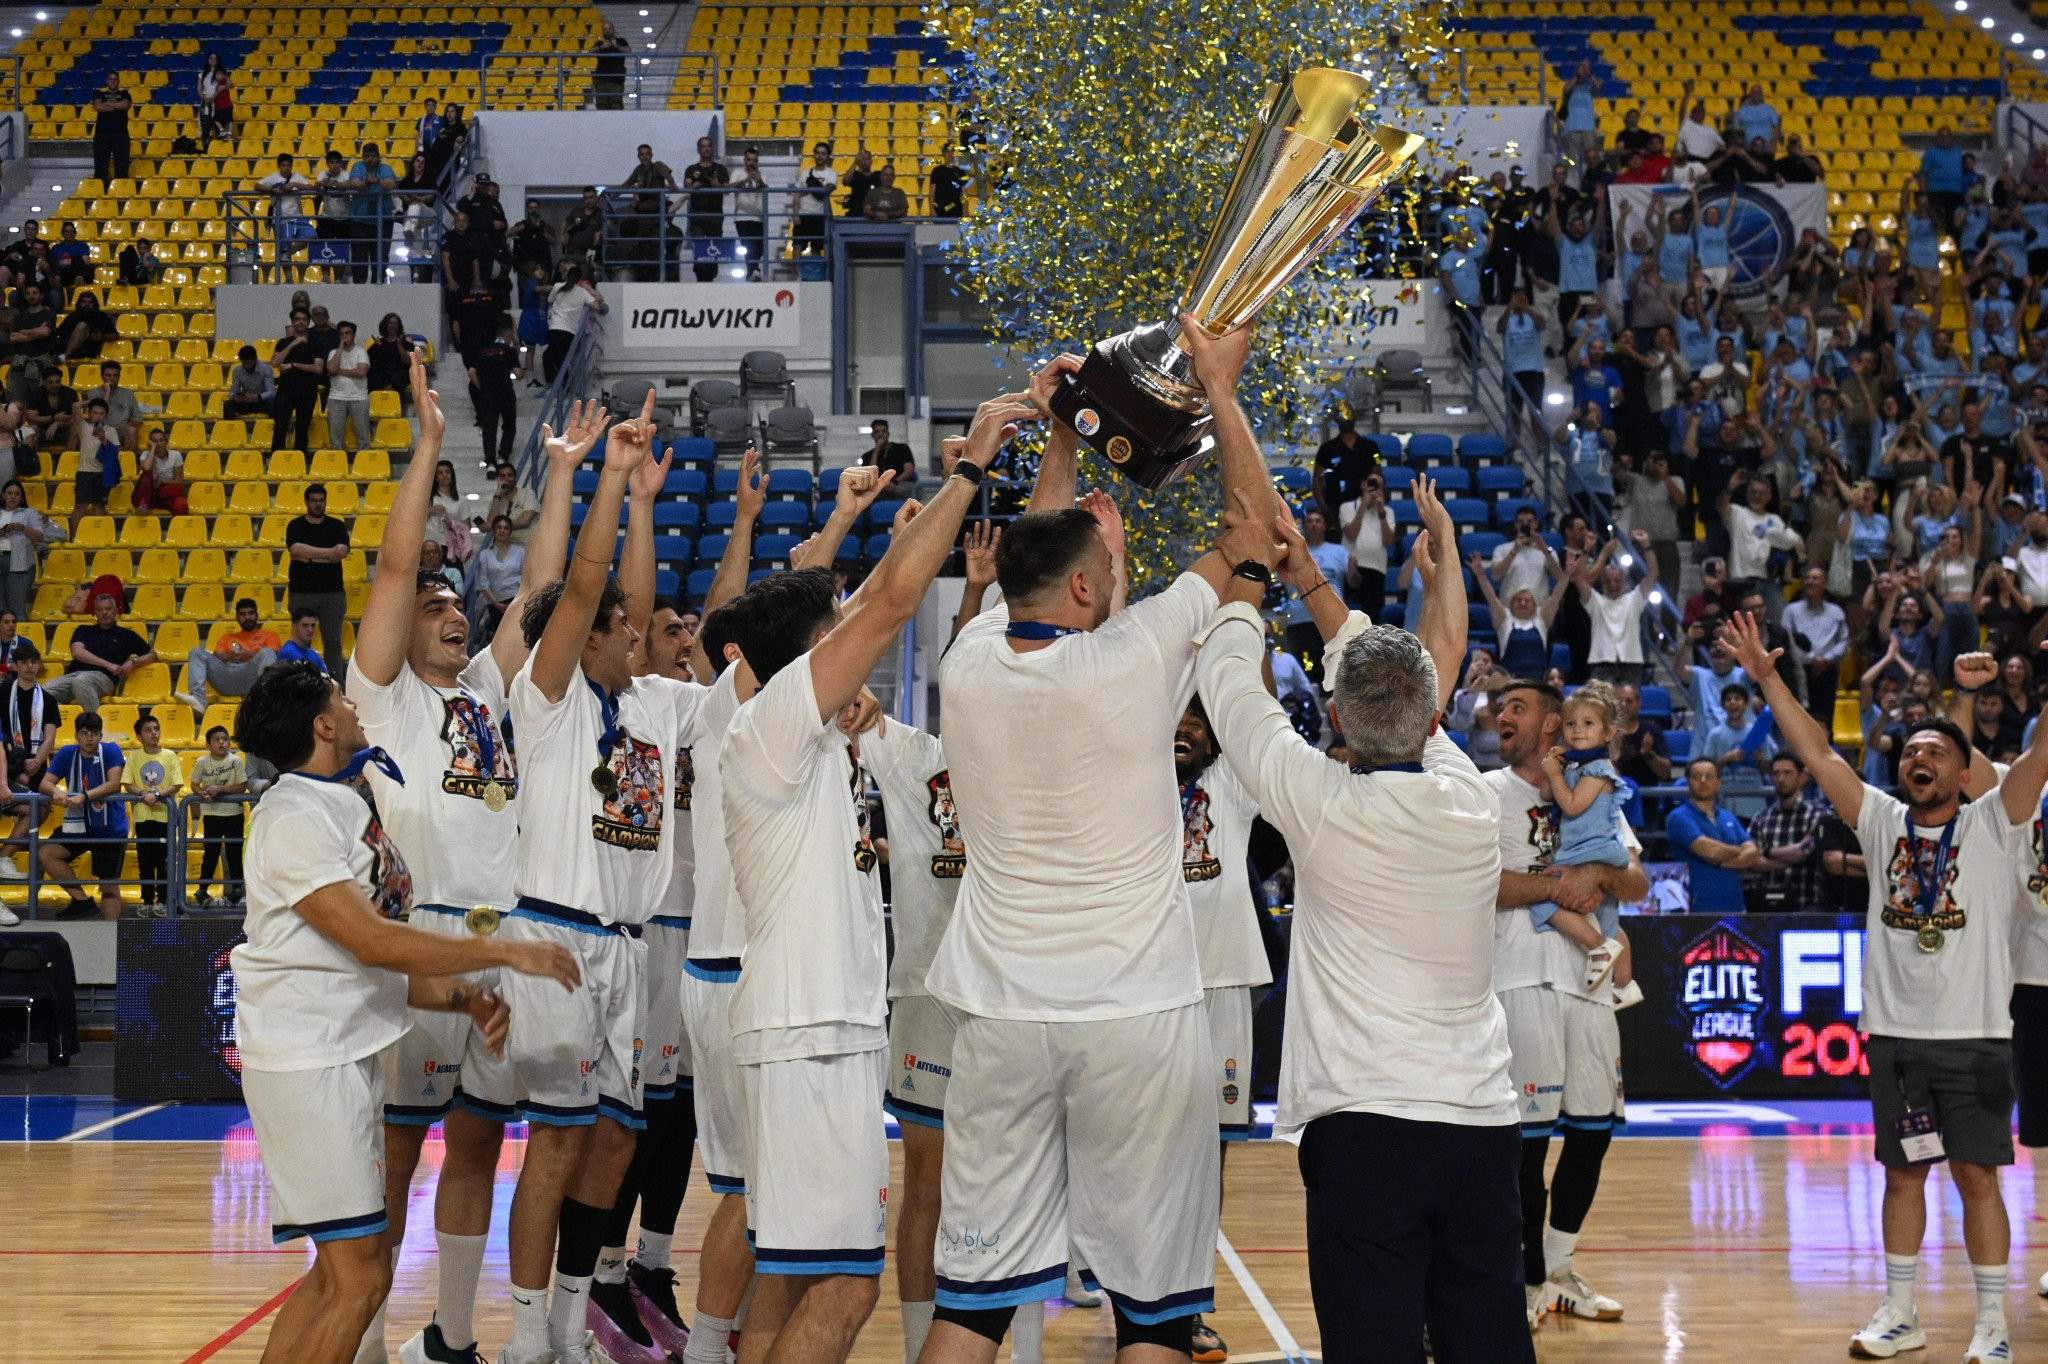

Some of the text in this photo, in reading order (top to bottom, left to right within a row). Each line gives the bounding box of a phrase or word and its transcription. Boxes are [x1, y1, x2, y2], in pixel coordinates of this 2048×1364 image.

[1683, 964, 1764, 1004] ELITE
[1780, 929, 1864, 1015] FI
[1692, 1011, 1755, 1040] LEAGUE
[1782, 1023, 1870, 1076] 20
